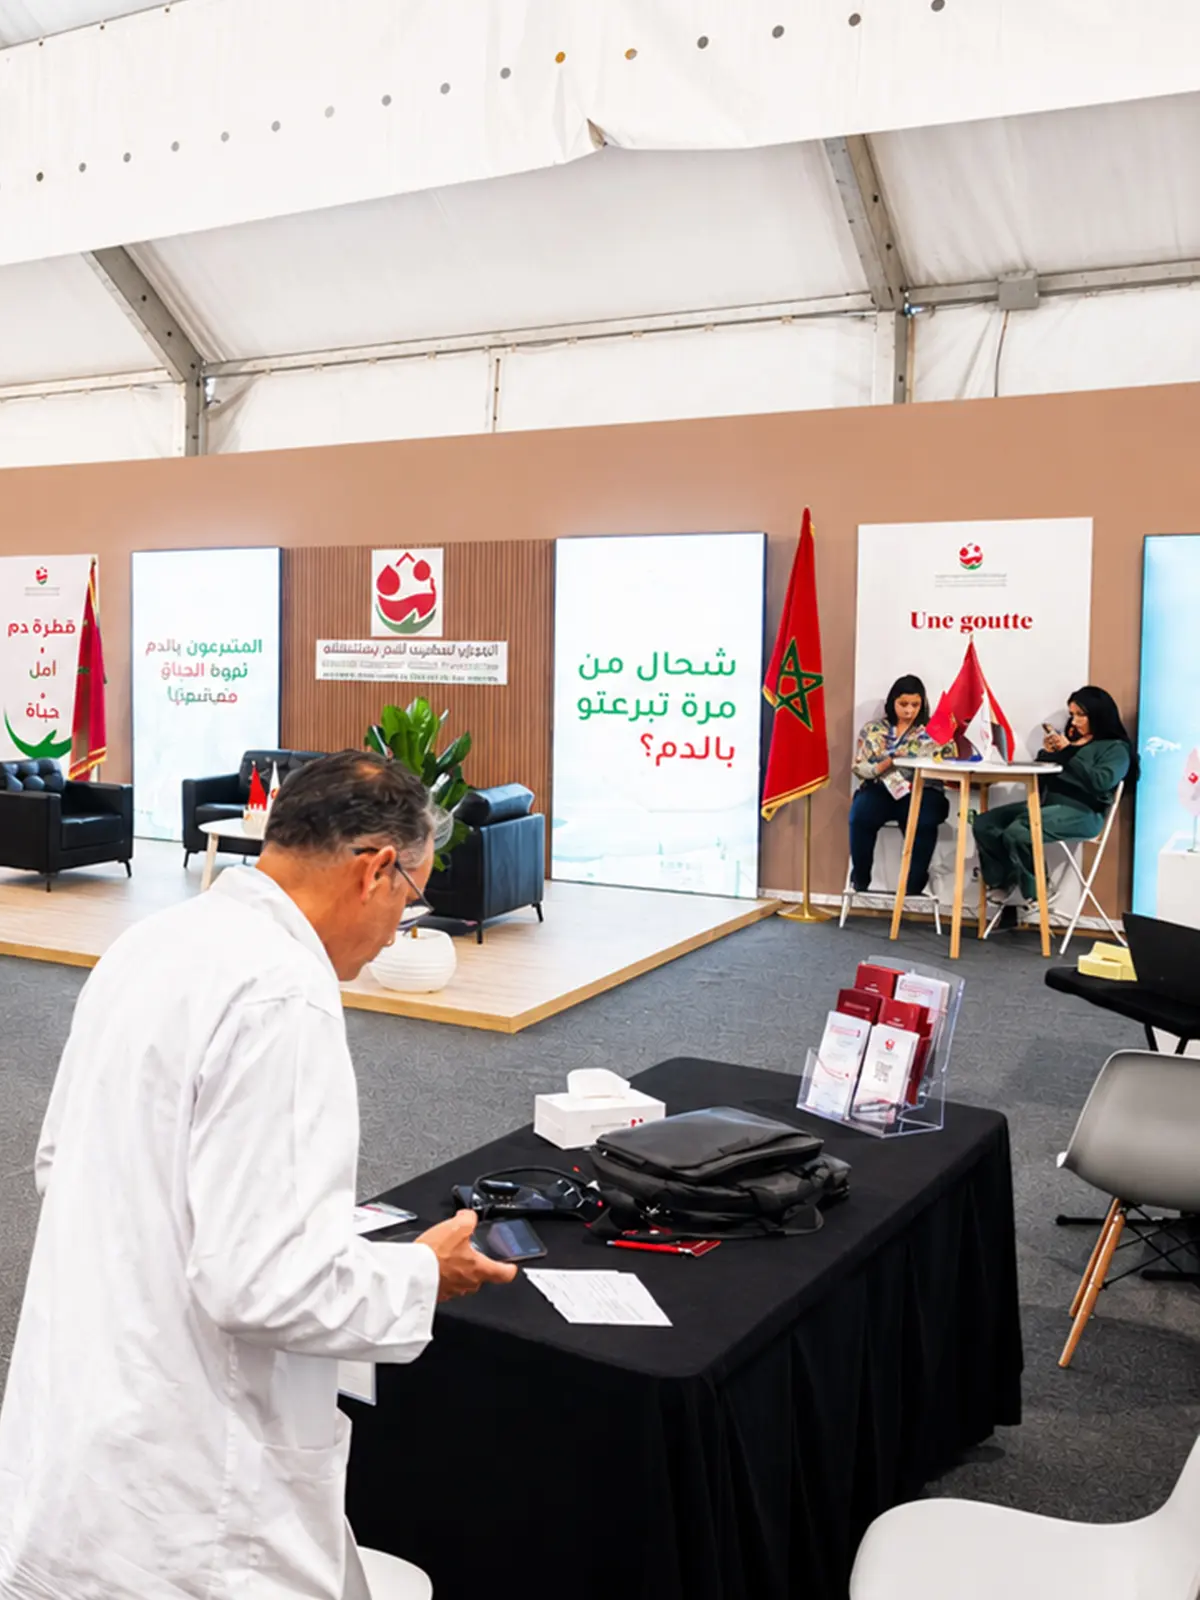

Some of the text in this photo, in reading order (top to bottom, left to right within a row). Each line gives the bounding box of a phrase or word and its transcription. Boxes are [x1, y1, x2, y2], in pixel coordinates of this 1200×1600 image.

[7, 618, 76, 638] قطرة دم
[910, 611, 1033, 634] Une goutte
[578, 647, 736, 682] شحال من
[577, 691, 736, 725] مرة تبرعتو
[640, 732, 735, 768] بالدم؟
